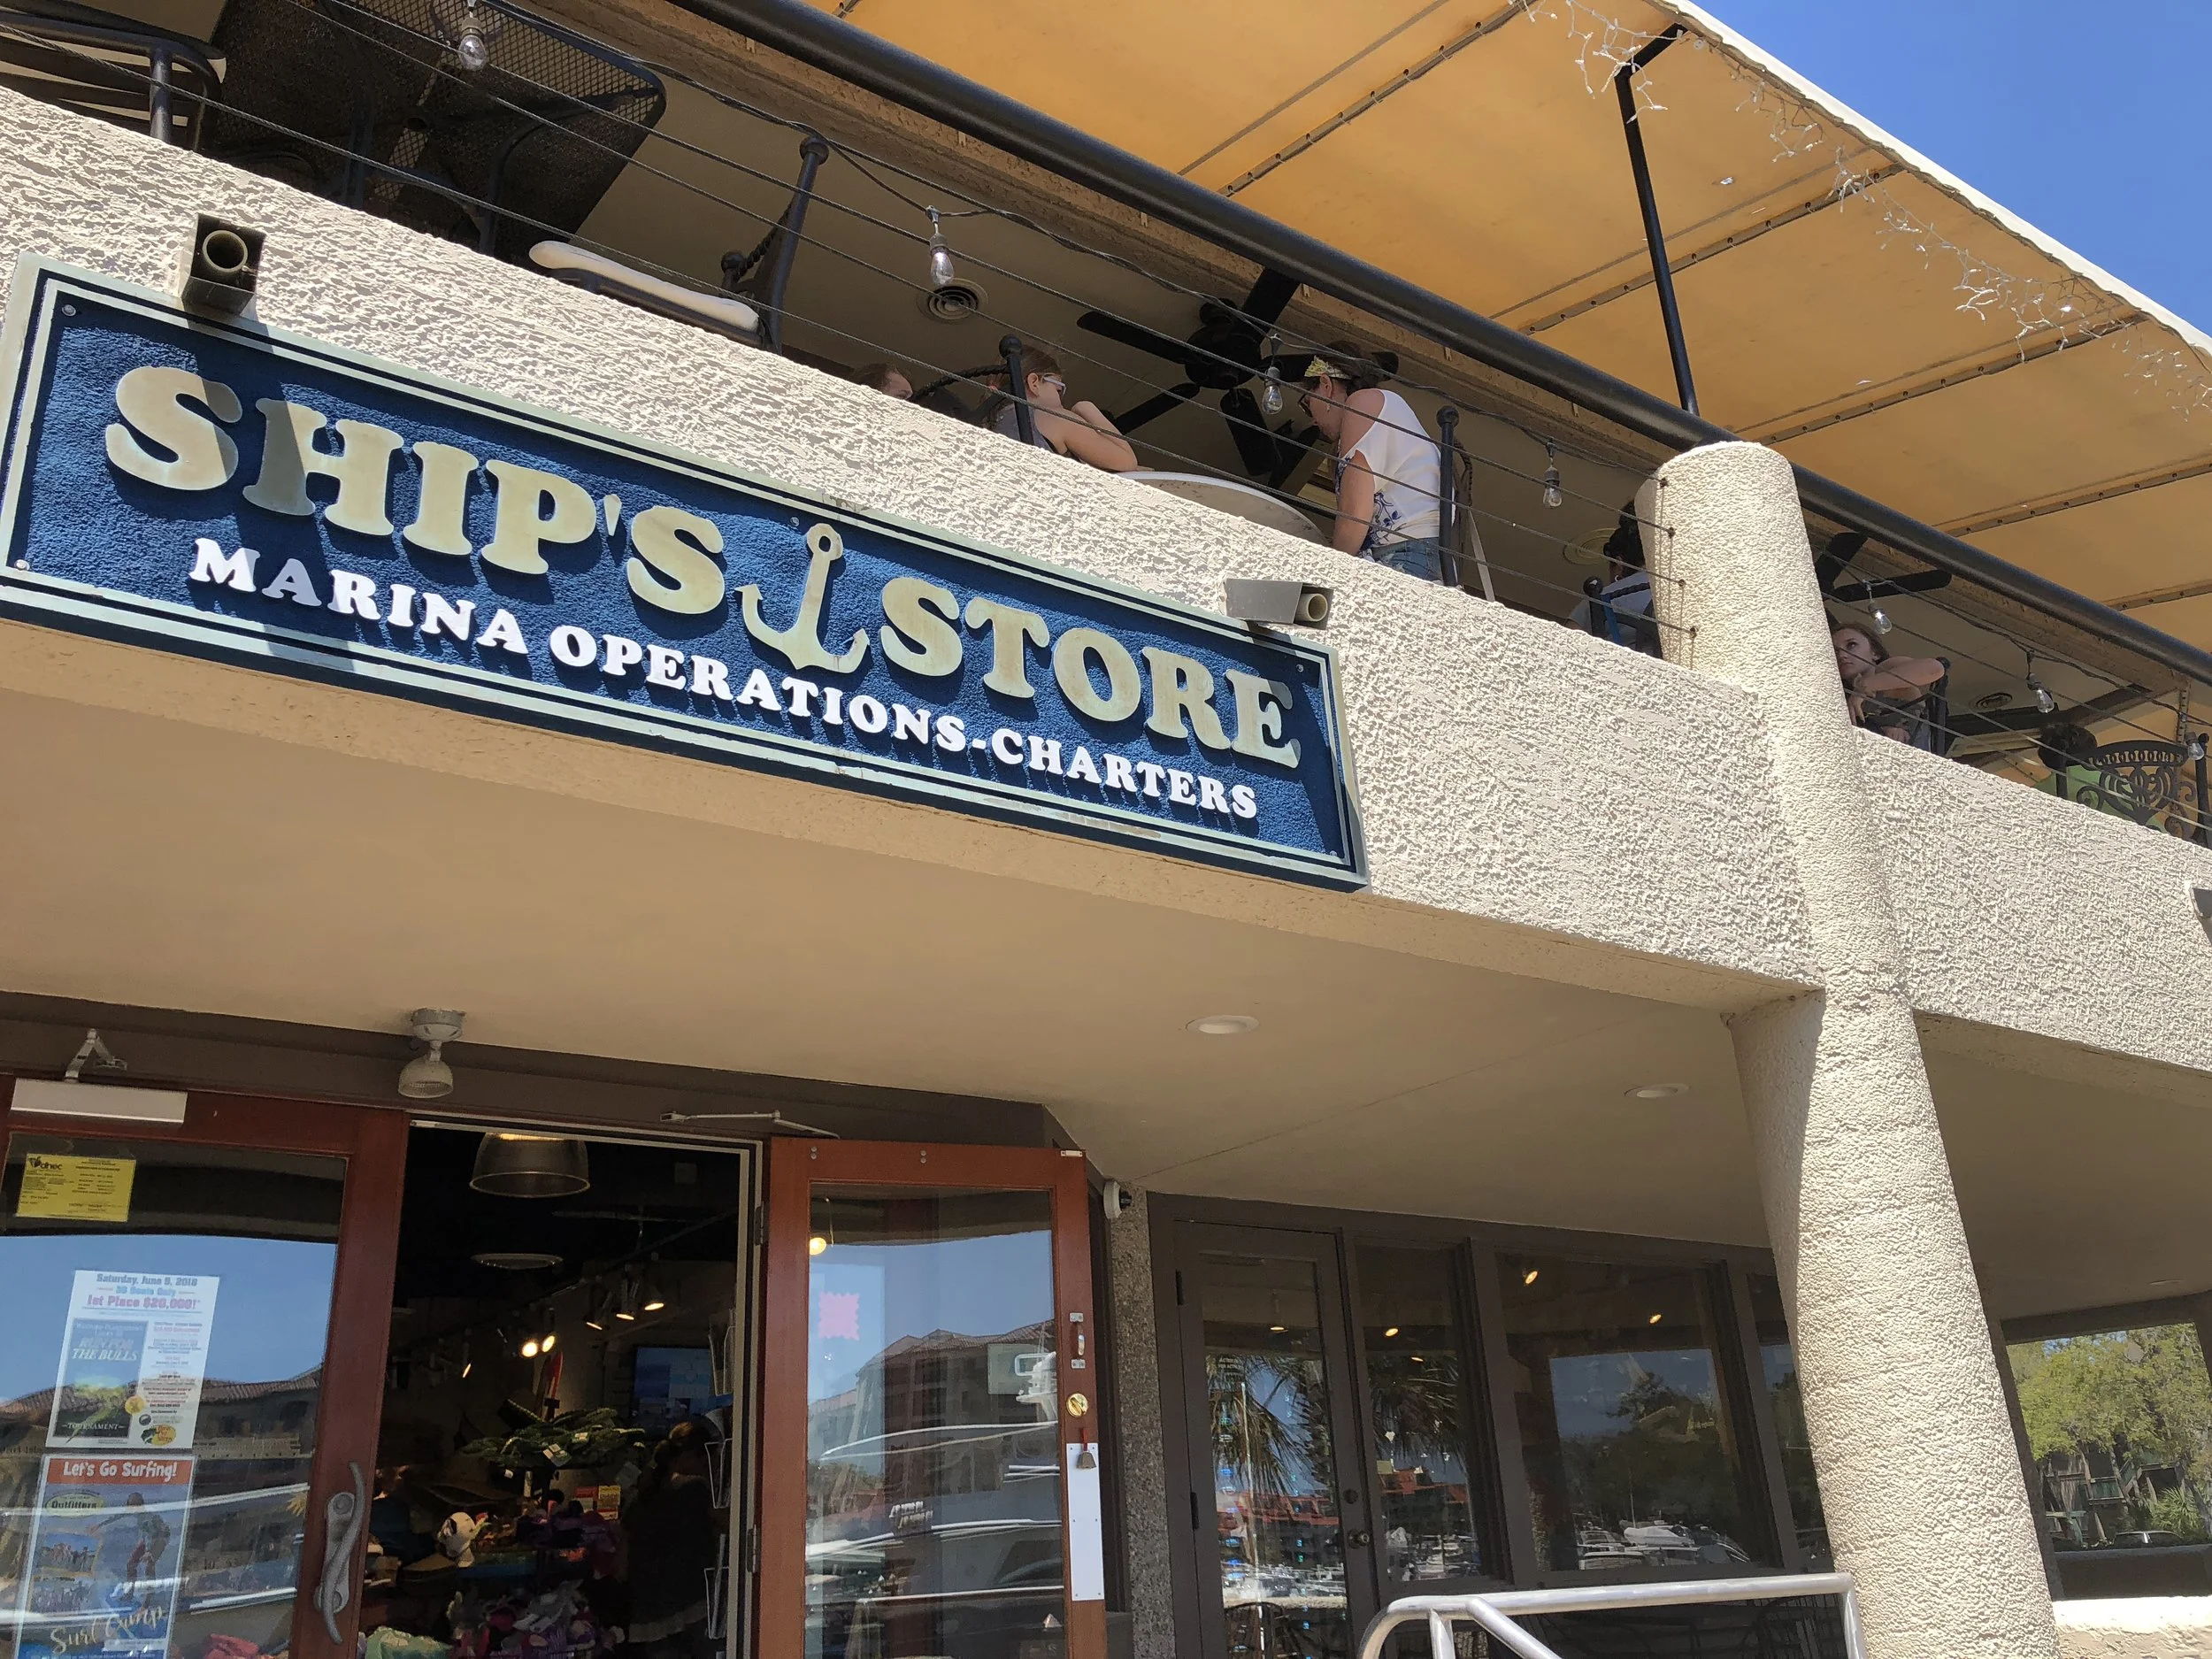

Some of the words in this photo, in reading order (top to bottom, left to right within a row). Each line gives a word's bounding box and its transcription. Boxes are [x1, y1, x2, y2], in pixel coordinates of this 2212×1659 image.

[105, 366, 726, 615] SHIP'S
[879, 577, 1302, 769] STORE
[188, 538, 529, 655] MARINA
[142, 1276, 162, 1285] June
[107, 1295, 140, 1307] Place
[72, 1348, 98, 1360] THE
[98, 1349, 137, 1361] BULLS
[63, 1461, 95, 1477] Let's
[99, 1462, 117, 1477] Go
[121, 1461, 178, 1482] Surfing!
